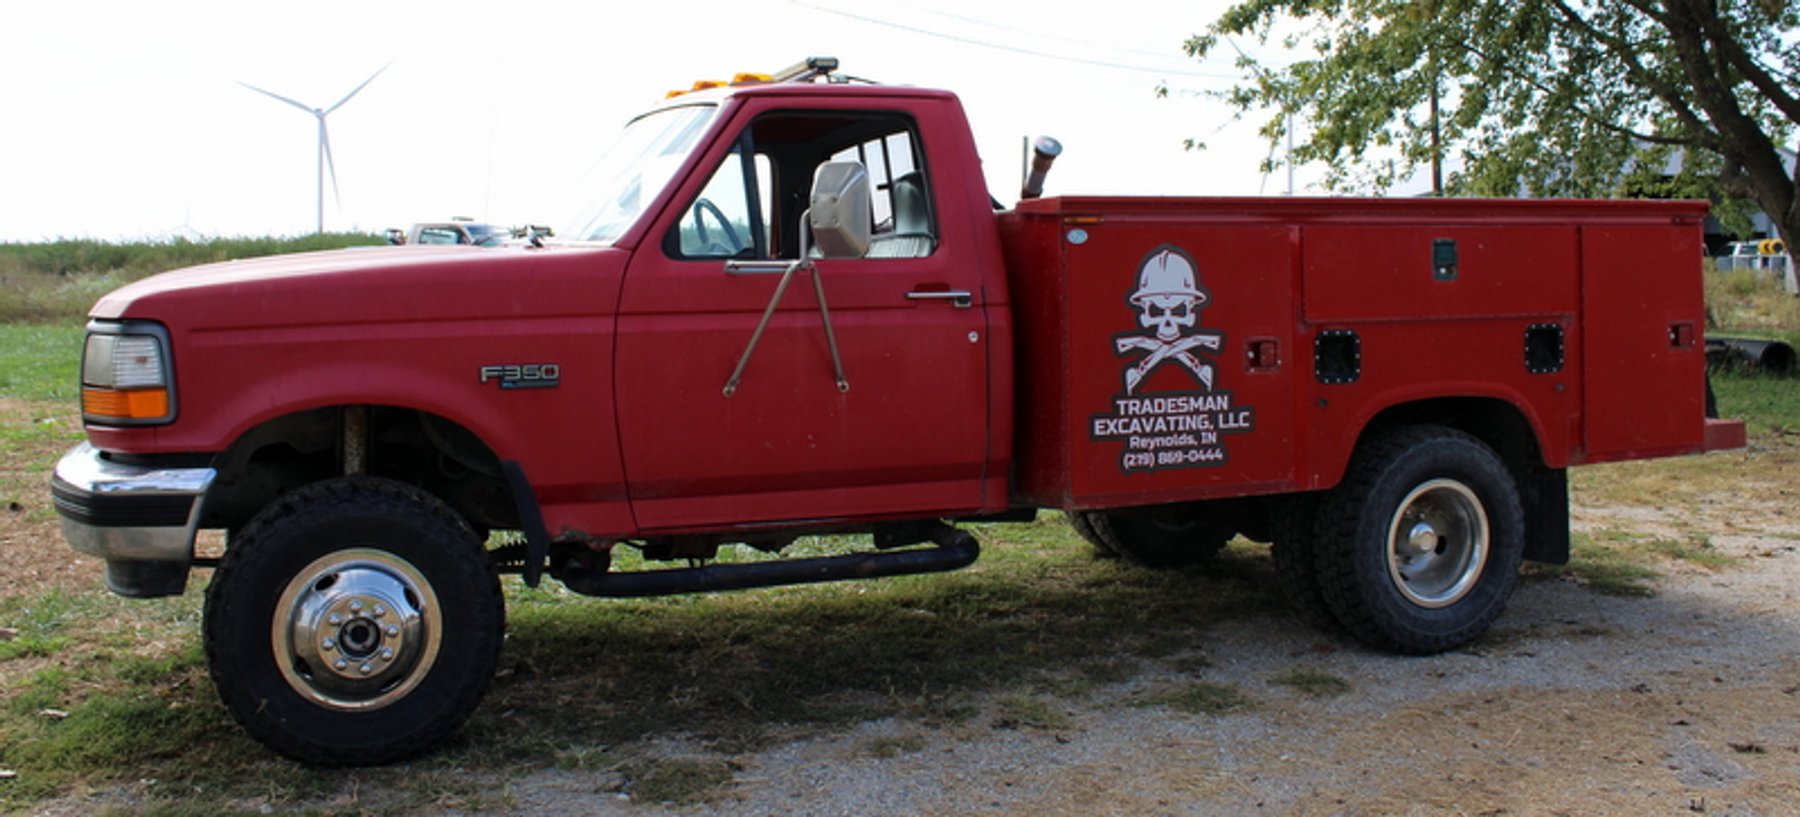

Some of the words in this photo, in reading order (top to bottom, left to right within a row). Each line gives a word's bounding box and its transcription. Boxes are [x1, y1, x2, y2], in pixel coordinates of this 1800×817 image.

[481, 365, 559, 382] F350
[1116, 395, 1229, 416] TRADESMAN
[1094, 414, 1214, 436] EXCAVATING,
[1219, 412, 1250, 428] LLC
[1130, 434, 1198, 450] Reynolds,
[1201, 432, 1217, 444] IN
[1158, 448, 1223, 464] 869-0444
